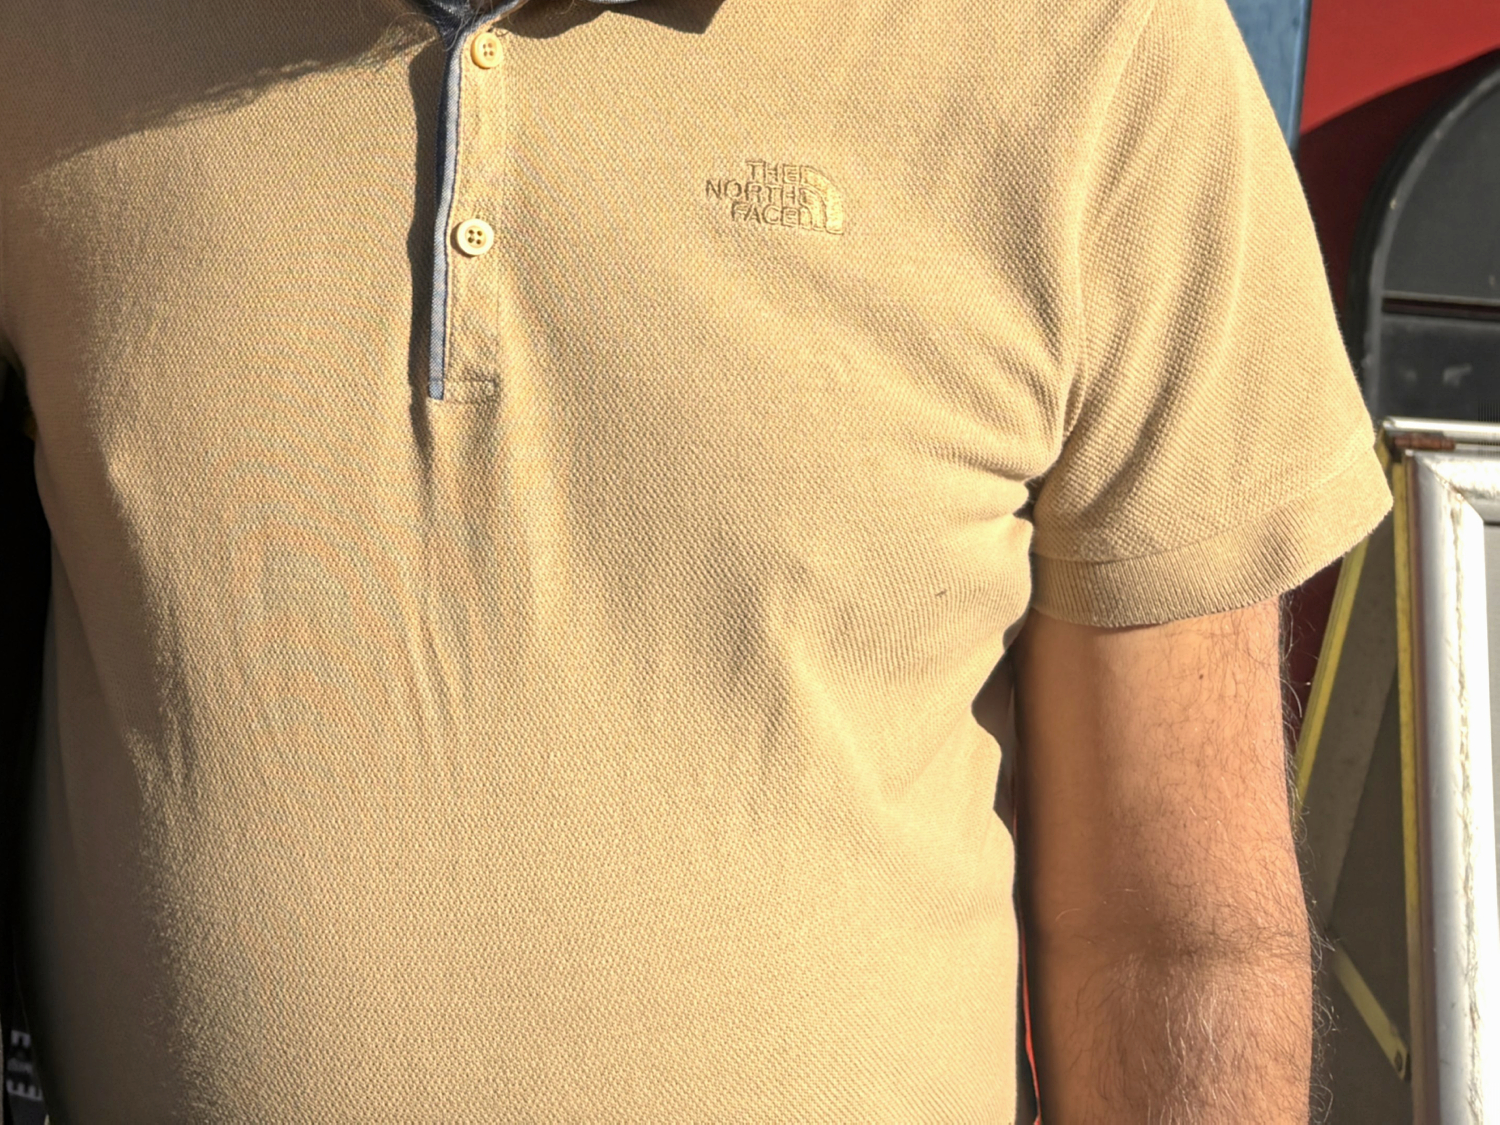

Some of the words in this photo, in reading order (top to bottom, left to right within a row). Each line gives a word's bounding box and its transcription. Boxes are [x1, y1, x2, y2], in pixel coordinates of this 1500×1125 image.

[745, 159, 801, 184] THE
[705, 178, 797, 206] NORTH
[731, 201, 801, 228] FACE
